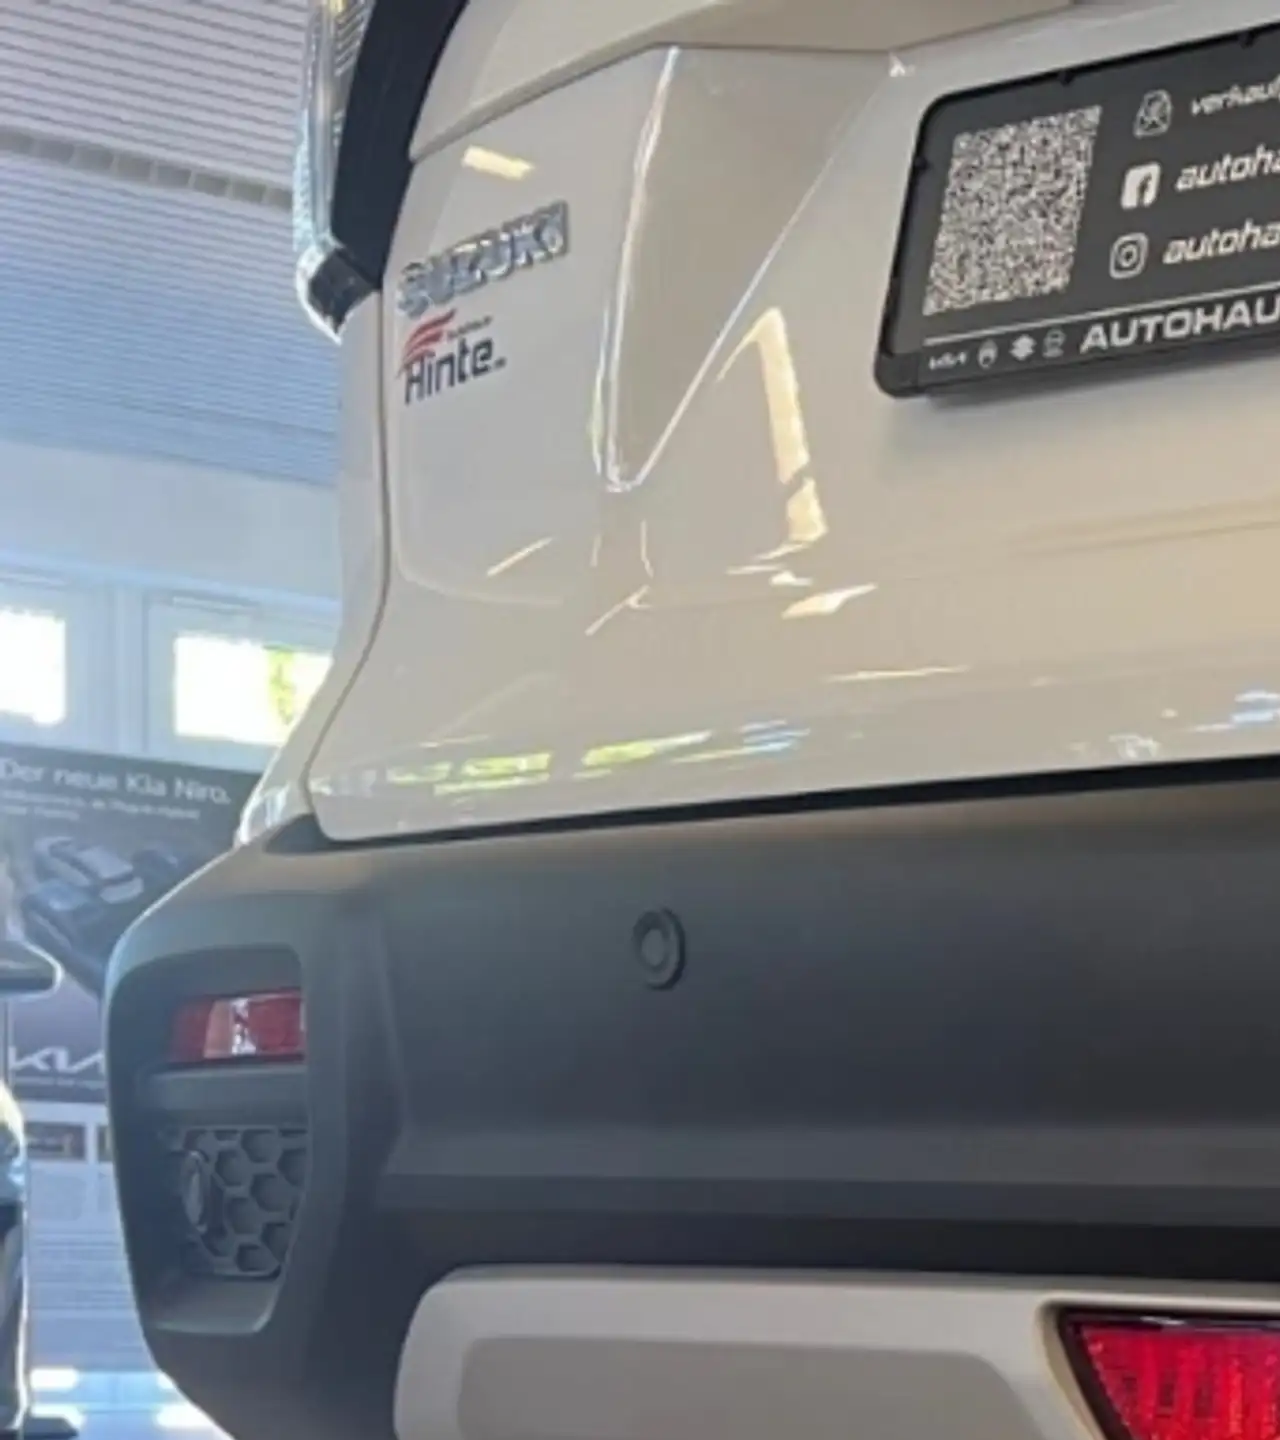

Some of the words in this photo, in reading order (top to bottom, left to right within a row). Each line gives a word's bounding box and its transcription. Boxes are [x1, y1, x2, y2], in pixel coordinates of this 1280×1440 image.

[396, 199, 569, 318] SUZUKI
[0, 757, 44, 783] Der
[53, 767, 118, 792] neue
[125, 771, 166, 797] Kia
